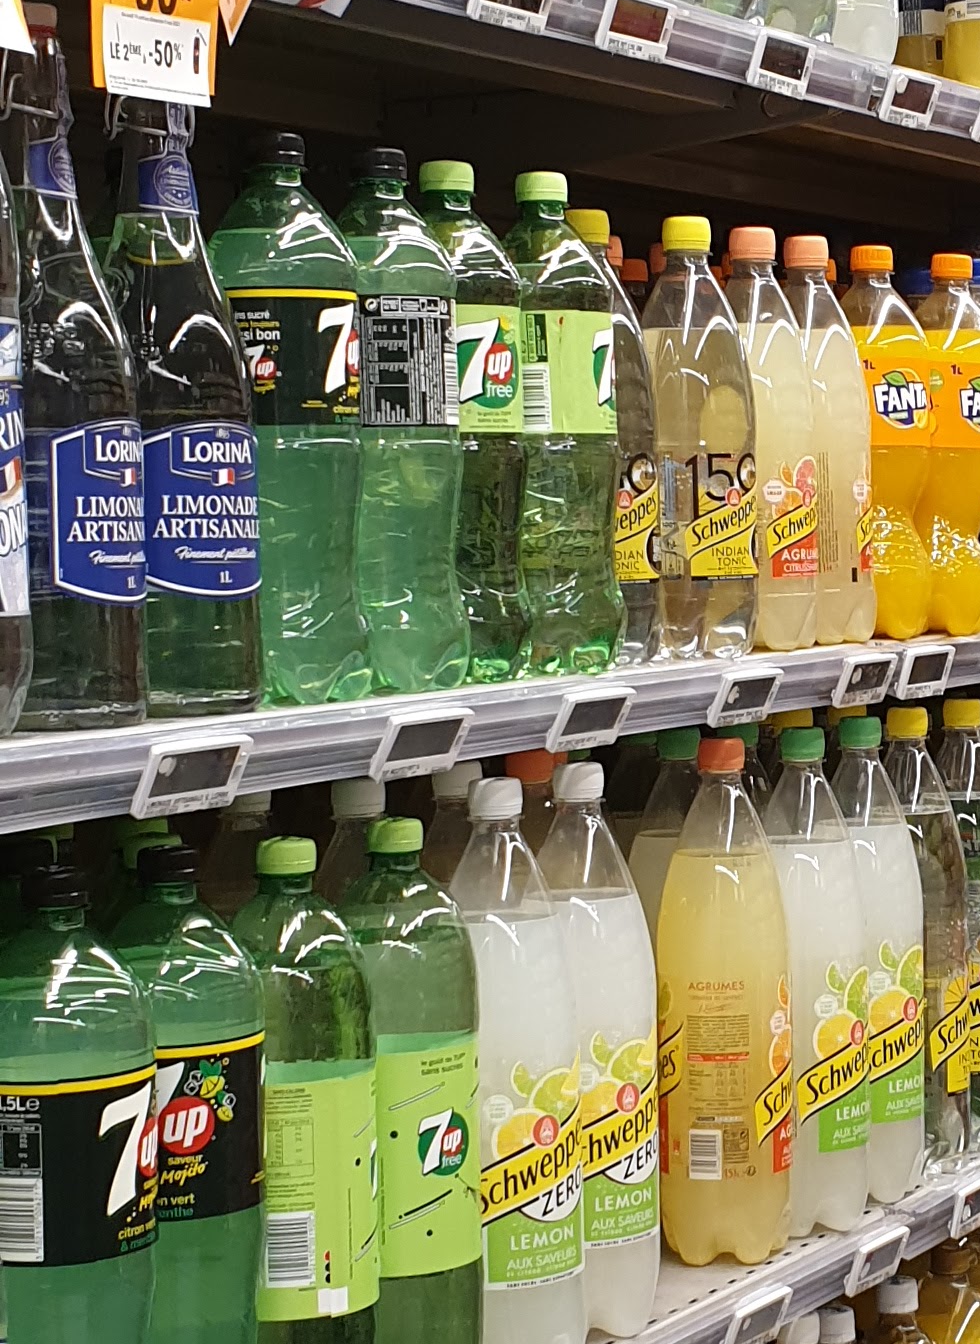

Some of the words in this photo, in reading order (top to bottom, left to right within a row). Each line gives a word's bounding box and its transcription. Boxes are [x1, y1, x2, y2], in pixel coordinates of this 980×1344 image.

[109, 40, 121, 60] LE
[247, 308, 271, 320] sucré
[256, 328, 281, 341] bon
[862, 359, 876, 370] 1L
[950, 363, 964, 376] 1L
[486, 381, 514, 401] free
[873, 378, 929, 410] FANTA
[182, 432, 252, 467] LORINA
[161, 493, 257, 518] LIMONADE
[614, 491, 657, 533] eppes
[153, 516, 260, 541] ARTISANALE
[615, 549, 645, 562] DIAN
[711, 546, 751, 557] INDIAN
[615, 560, 641, 571] ONIC
[717, 557, 747, 567] TONIC
[219, 569, 232, 585] 1L
[687, 980, 746, 993] AGRUMES
[169, 1192, 196, 1206] vert
[594, 1187, 653, 1213] LEMON
[591, 1216, 616, 1230] AUX
[510, 1222, 575, 1253] LEMON
[506, 1254, 534, 1271] AUX
